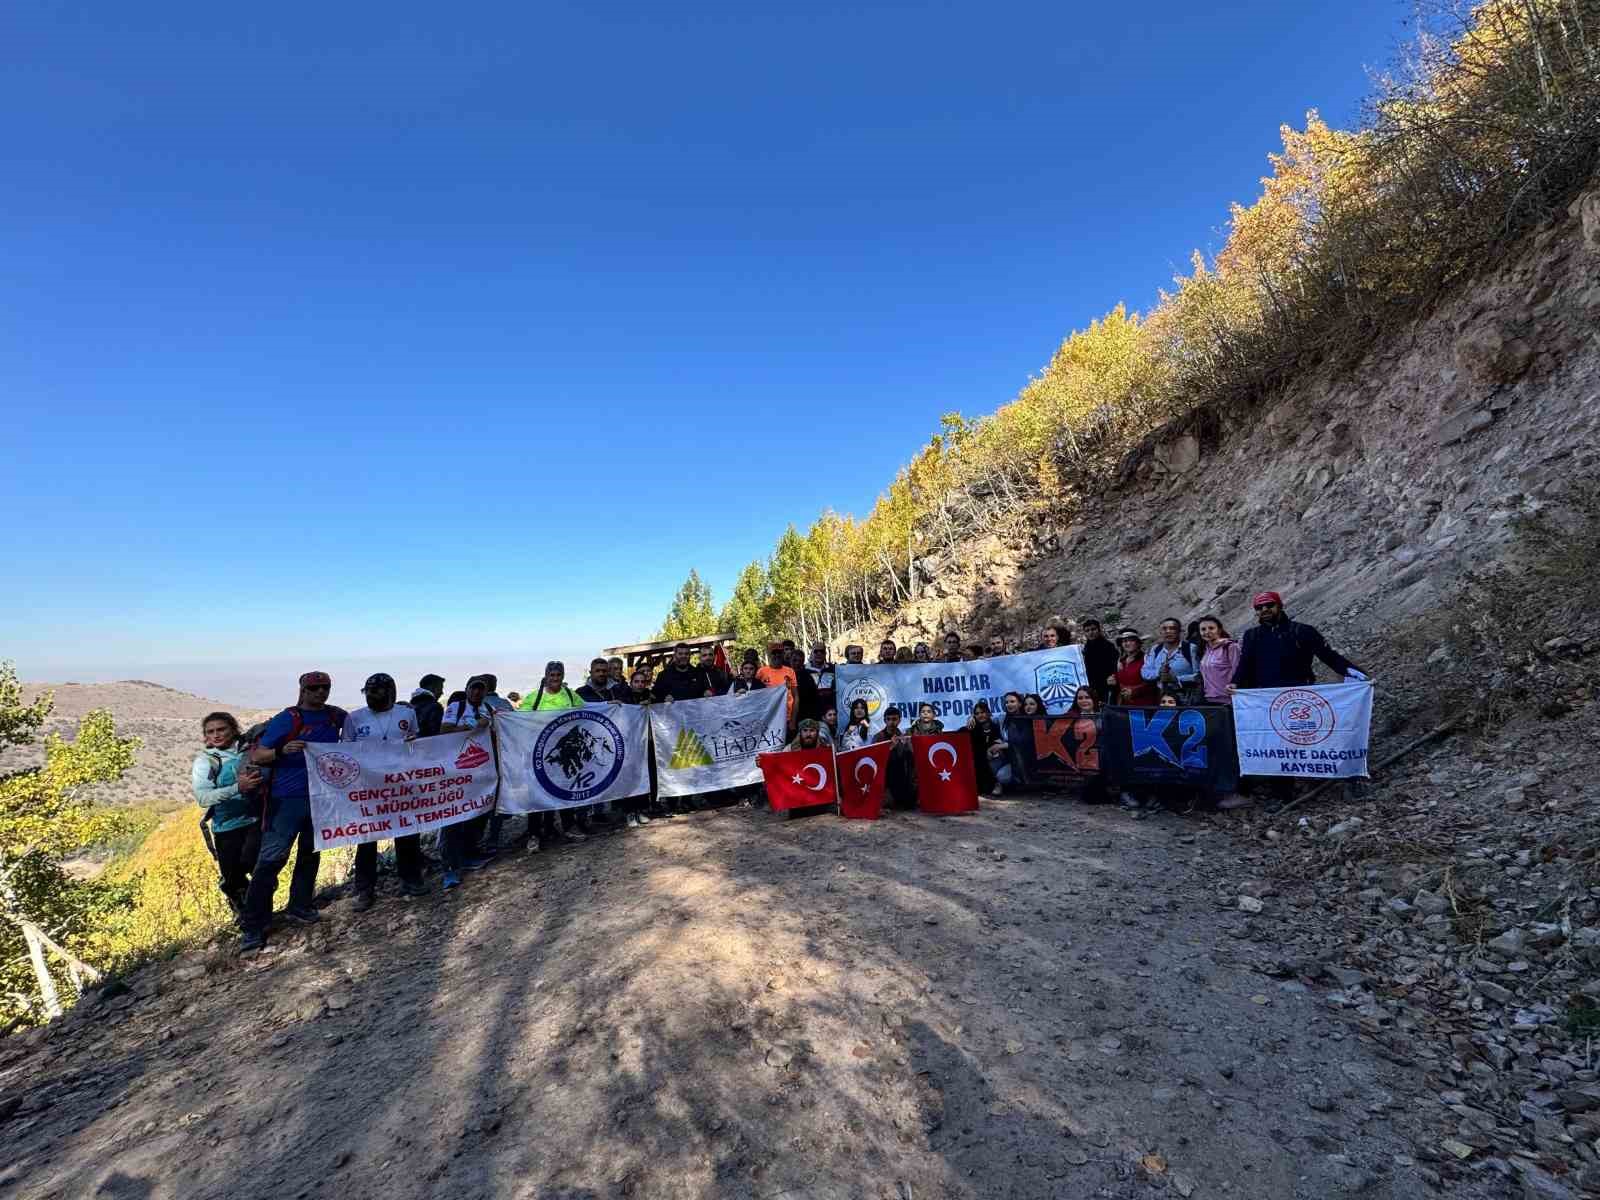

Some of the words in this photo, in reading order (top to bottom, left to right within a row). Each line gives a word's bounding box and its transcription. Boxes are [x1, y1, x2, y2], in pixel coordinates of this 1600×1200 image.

[923, 674, 991, 694] HACILAR
[889, 701, 925, 719] RV
[936, 699, 971, 717] SPOR
[712, 728, 785, 757] HADAK
[1032, 719, 1100, 773] K2
[1128, 709, 1208, 769] K2
[1246, 747, 1307, 759] SAHABİYE
[384, 765, 446, 784] KAYSERİ
[1281, 762, 1338, 774] KAYSERİ
[349, 786, 414, 804] GENÇLİK
[419, 781, 435, 793] VE
[440, 775, 473, 790] SPOR
[360, 804, 373, 817] İL
[376, 790, 464, 815] MÜDÜRLÜĞÜ
[322, 819, 392, 841] DAĞCILIK
[400, 815, 412, 828] İL
[415, 794, 494, 825] TEMSİLCİLİĞ
